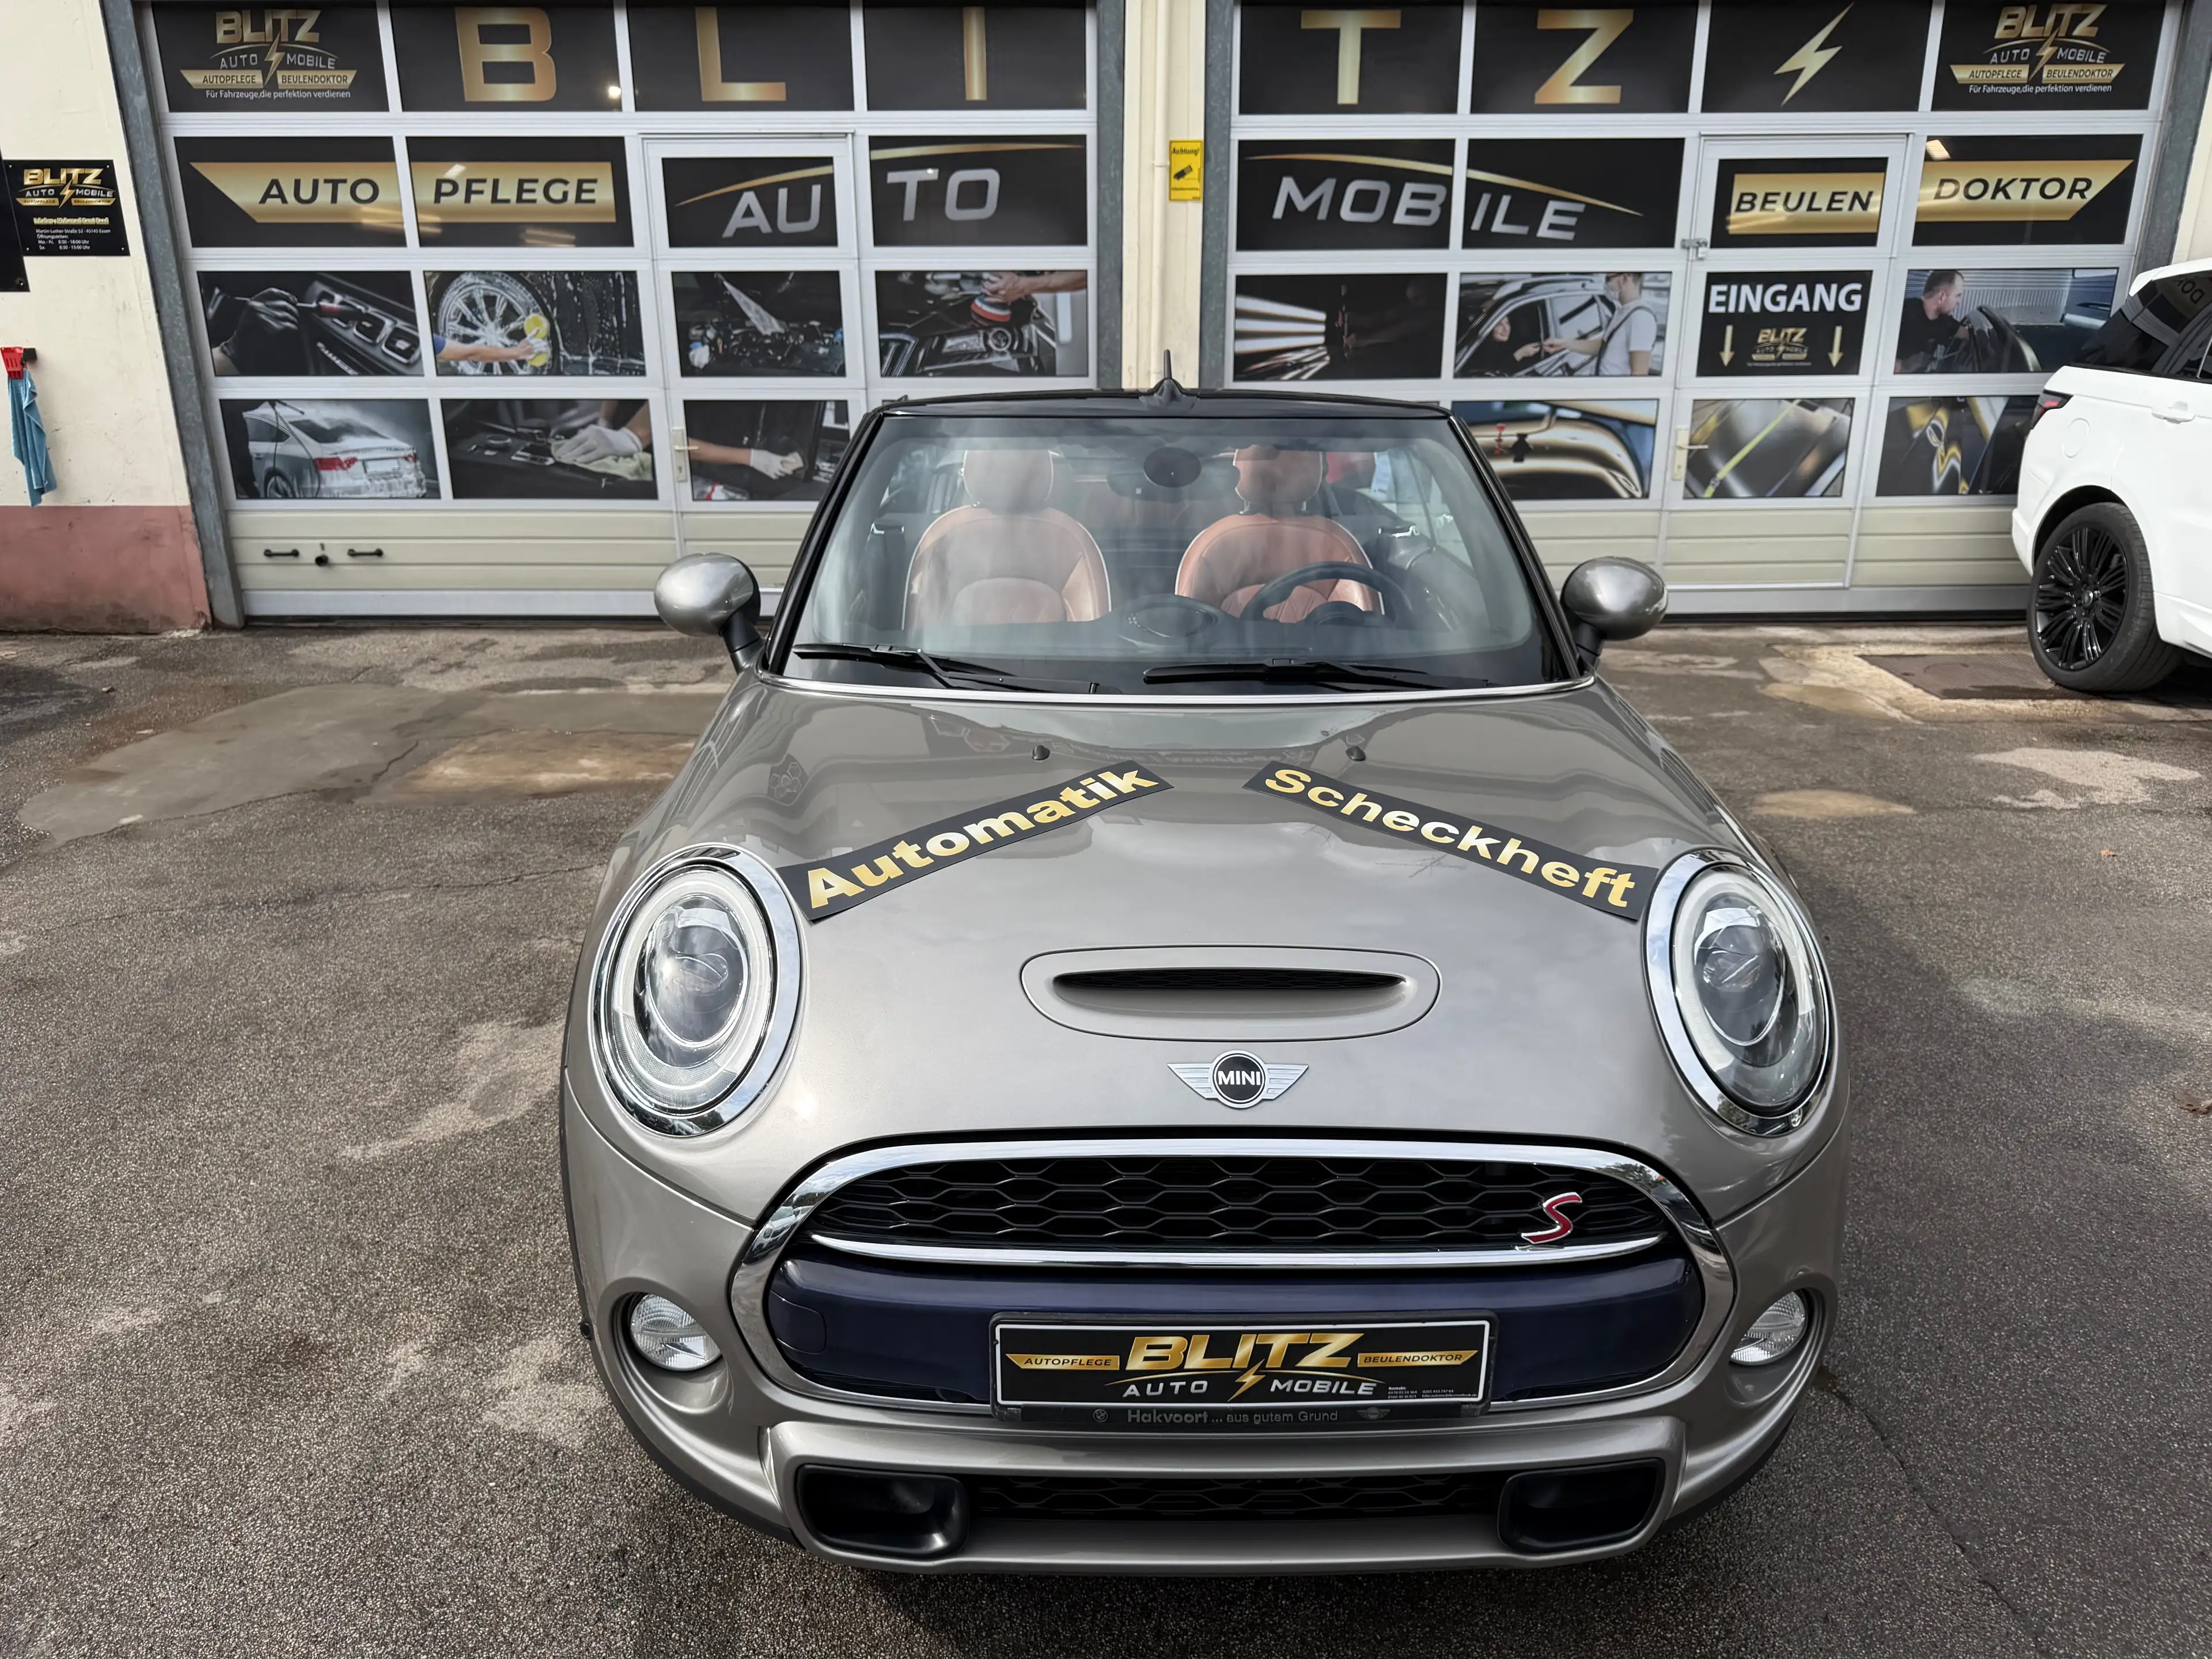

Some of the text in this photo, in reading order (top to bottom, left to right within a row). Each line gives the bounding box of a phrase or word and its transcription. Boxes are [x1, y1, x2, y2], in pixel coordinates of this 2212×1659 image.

[215, 9, 321, 44] BLITZ
[1994, 3, 2108, 39] BLITZ
[219, 53, 336, 70] AUTO MOBILE
[1989, 47, 2107, 65] AUTO MOBILE
[202, 74, 349, 84] AUTOPFLEGE BEULENDOKTOR
[1968, 69, 2114, 79] AUTOPFLEGE BEULENDOKTOR
[206, 89, 218, 99] Für
[273, 89, 312, 100] perfektion
[313, 89, 351, 99] verdienen
[1968, 85, 1981, 93] Für
[2035, 84, 2074, 94] perfektion
[2075, 84, 2112, 93] verdienen
[24, 168, 104, 185] BLITZ
[25, 188, 115, 198] AUTO MOBILE
[258, 177, 380, 205] AUTO
[433, 177, 599, 205] PFLEGE
[1933, 177, 2093, 201] DOKTOR
[1734, 191, 1874, 213] BEULEN
[1708, 283, 1863, 313] EINGANG
[1757, 327, 1808, 344] BLITZ
[808, 767, 1159, 909] Automatik
[1265, 769, 1635, 907] Scheckheft
[1218, 1070, 1261, 1086] MINI
[1521, 1191, 1583, 1244] S
[1126, 1333, 1365, 1371] BLITZ
[1363, 1354, 1463, 1363] BEULENDOKTOR
[1024, 1358, 1112, 1366] AUTOPFLEGE
[1122, 1379, 1377, 1397] AUTO MOBILE
[1127, 1409, 1209, 1423] Hakvoort
[1226, 1414, 1249, 1423] aus
[1253, 1413, 1294, 1425] gutem
[1298, 1411, 1339, 1422] Grund
